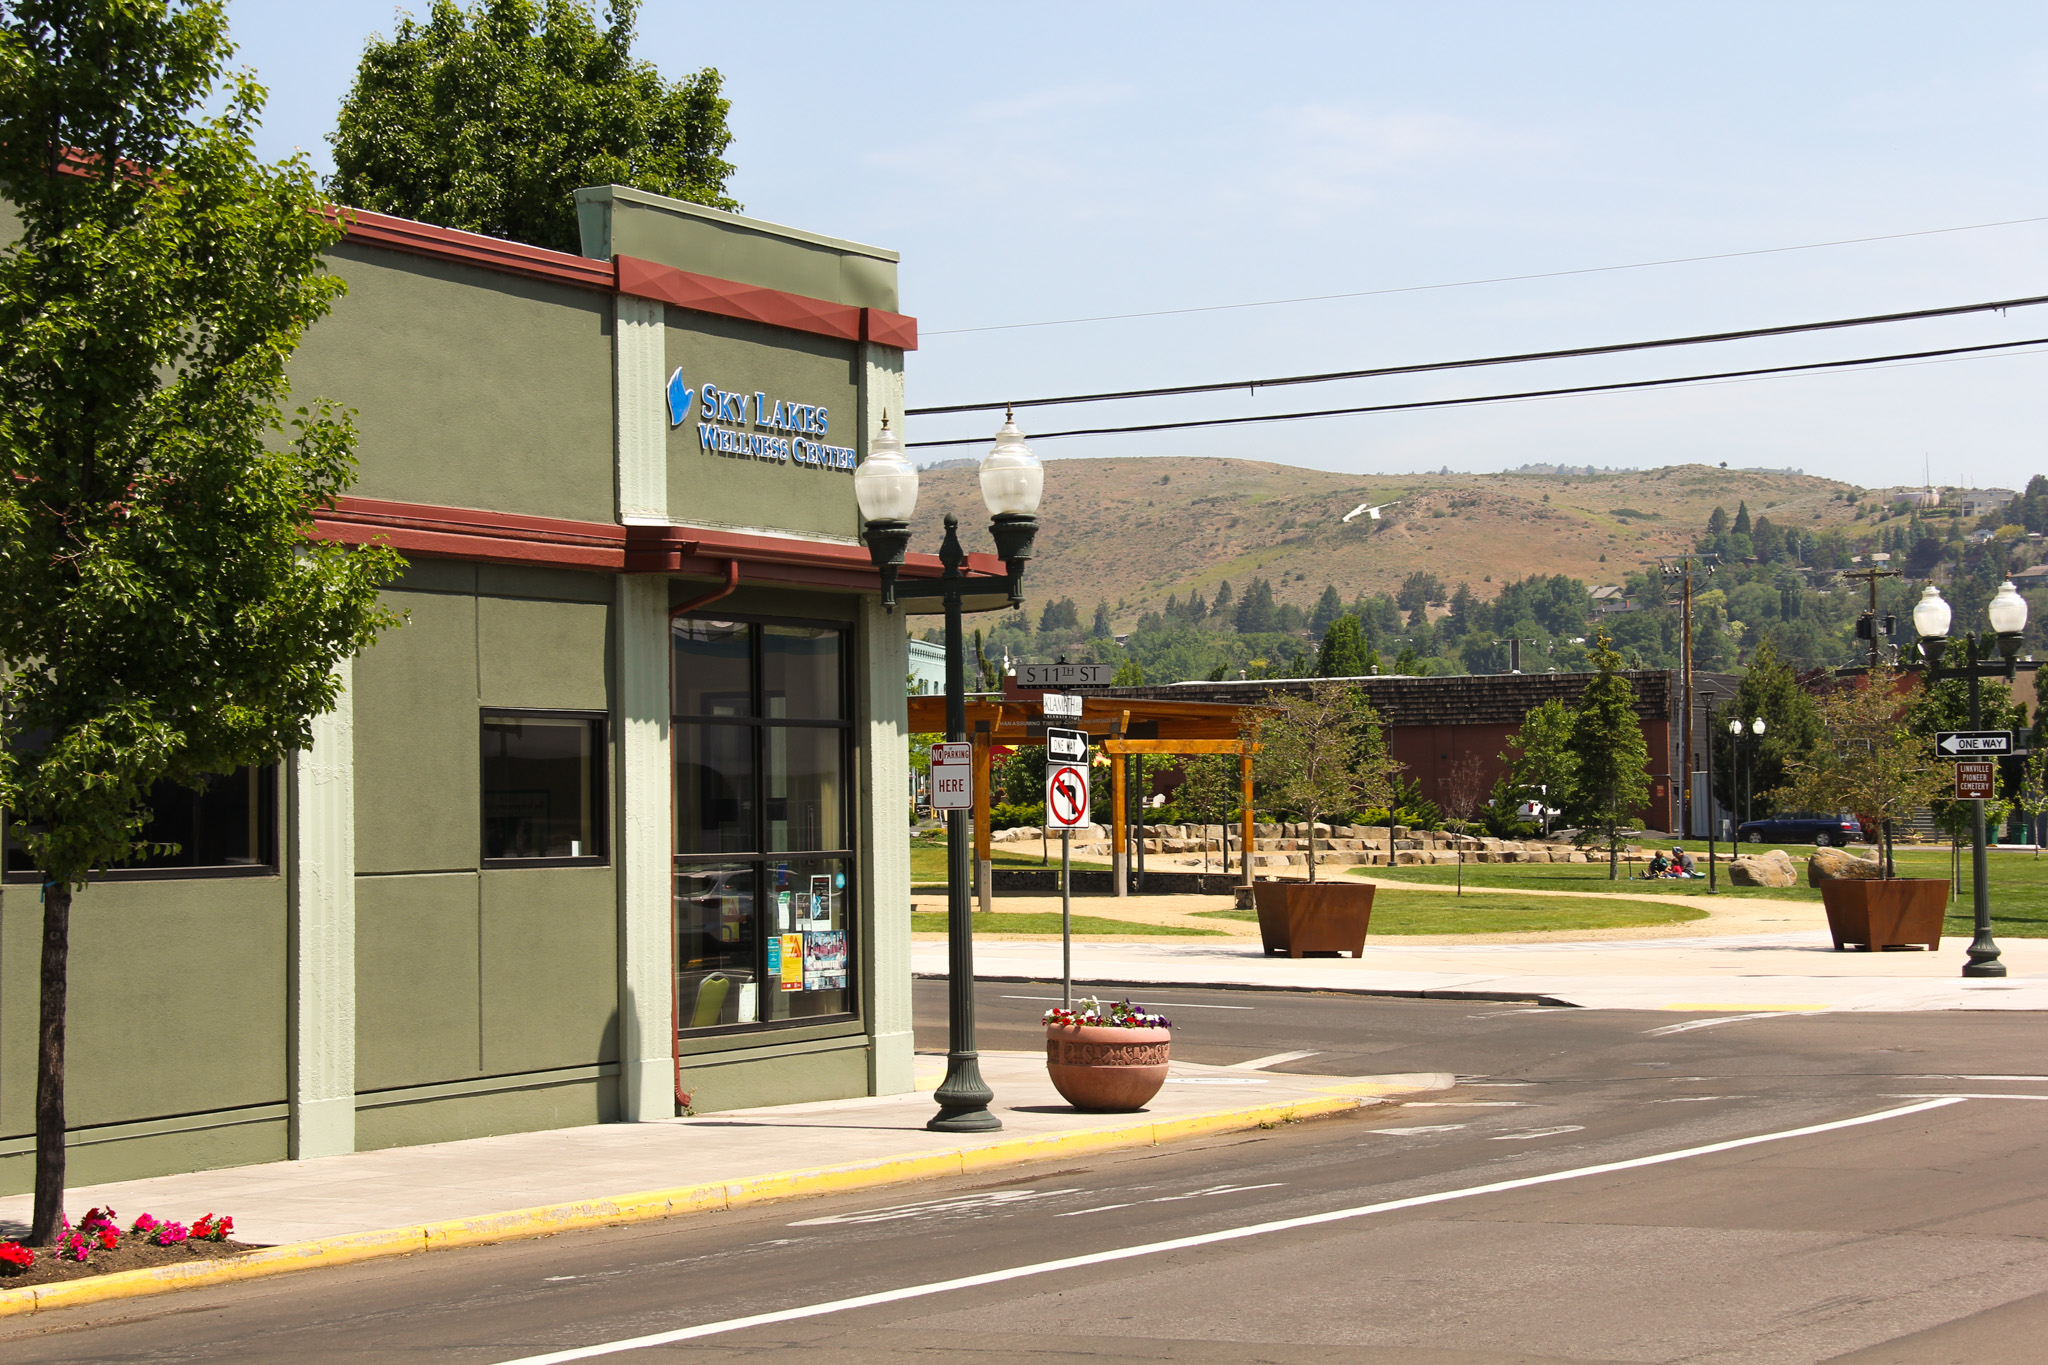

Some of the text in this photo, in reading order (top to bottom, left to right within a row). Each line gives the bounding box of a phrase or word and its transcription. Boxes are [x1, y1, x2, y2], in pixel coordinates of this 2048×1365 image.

[701, 383, 828, 436] SKY LAKES
[698, 422, 857, 470] WELLNESS CENTER
[1027, 666, 1100, 682] S 11TH ST
[1044, 696, 1076, 713] KLAMATH
[1054, 739, 1076, 753] ONE WAY
[1958, 739, 2004, 749] ONE WAY
[933, 749, 969, 762] NO PARKING
[1960, 765, 1989, 773] LINKVILLE
[1962, 773, 1987, 782] PIONEER
[939, 779, 964, 792] HERE
[1960, 782, 1990, 790] CEMETERY
